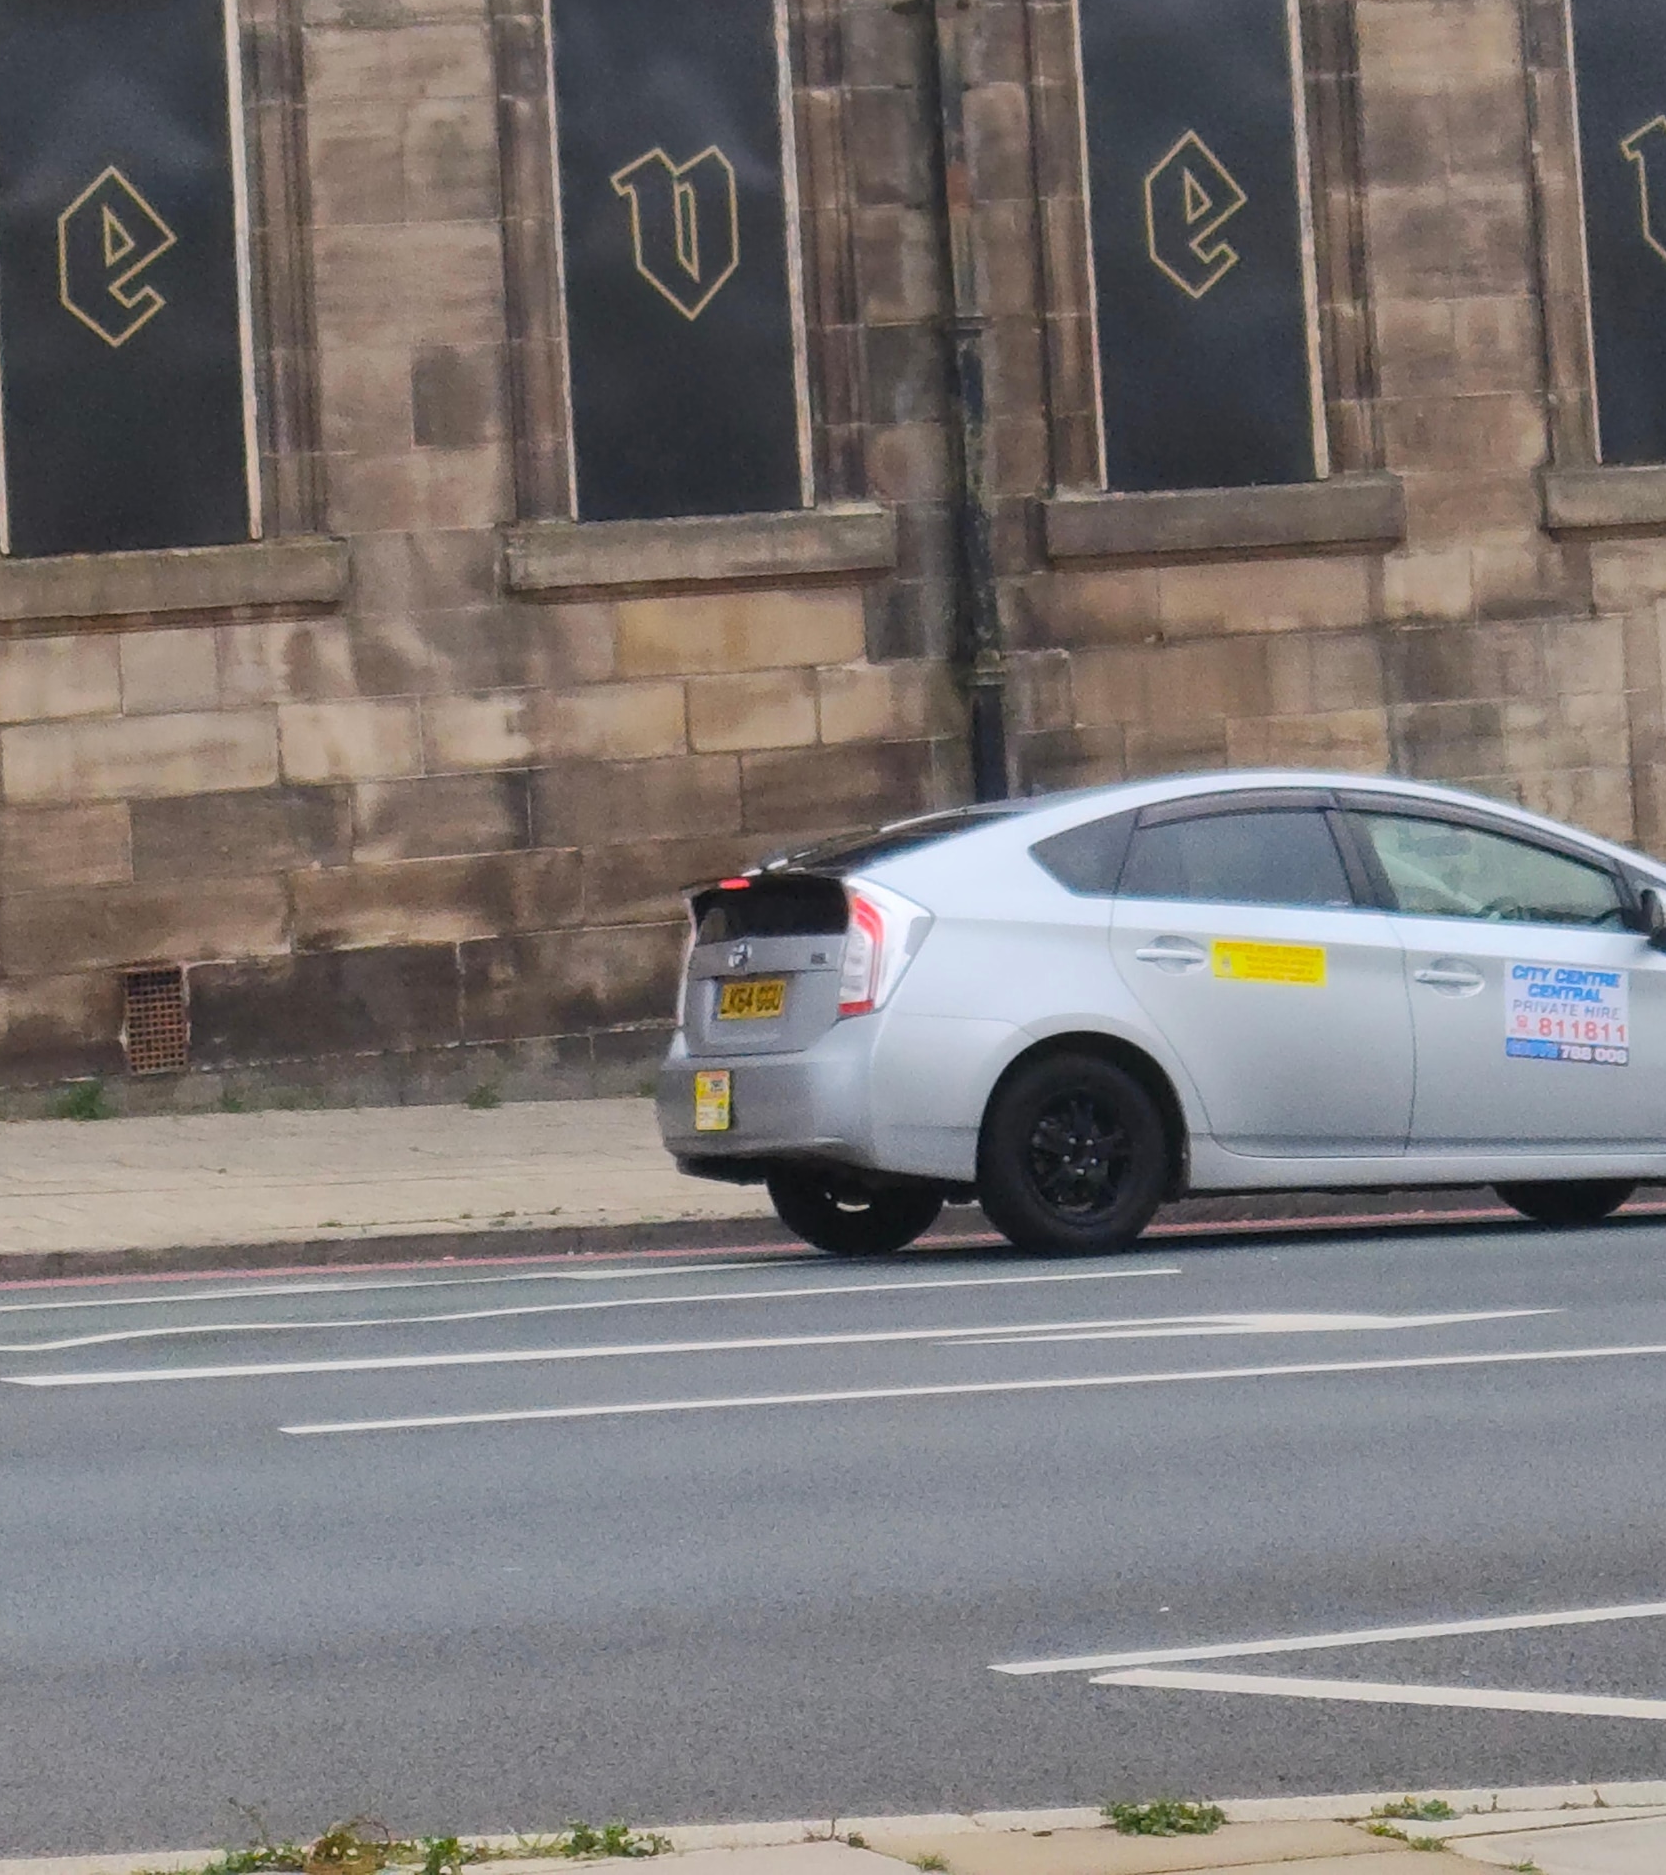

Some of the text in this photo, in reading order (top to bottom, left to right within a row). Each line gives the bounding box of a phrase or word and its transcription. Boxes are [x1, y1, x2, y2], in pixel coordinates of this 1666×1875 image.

[1512, 964, 1621, 988] CITY CENTRE
[1528, 983, 1603, 1003] CENTRAL
[1513, 999, 1621, 1020] PRIVATE HIRE
[1539, 1017, 1626, 1042] 811811
